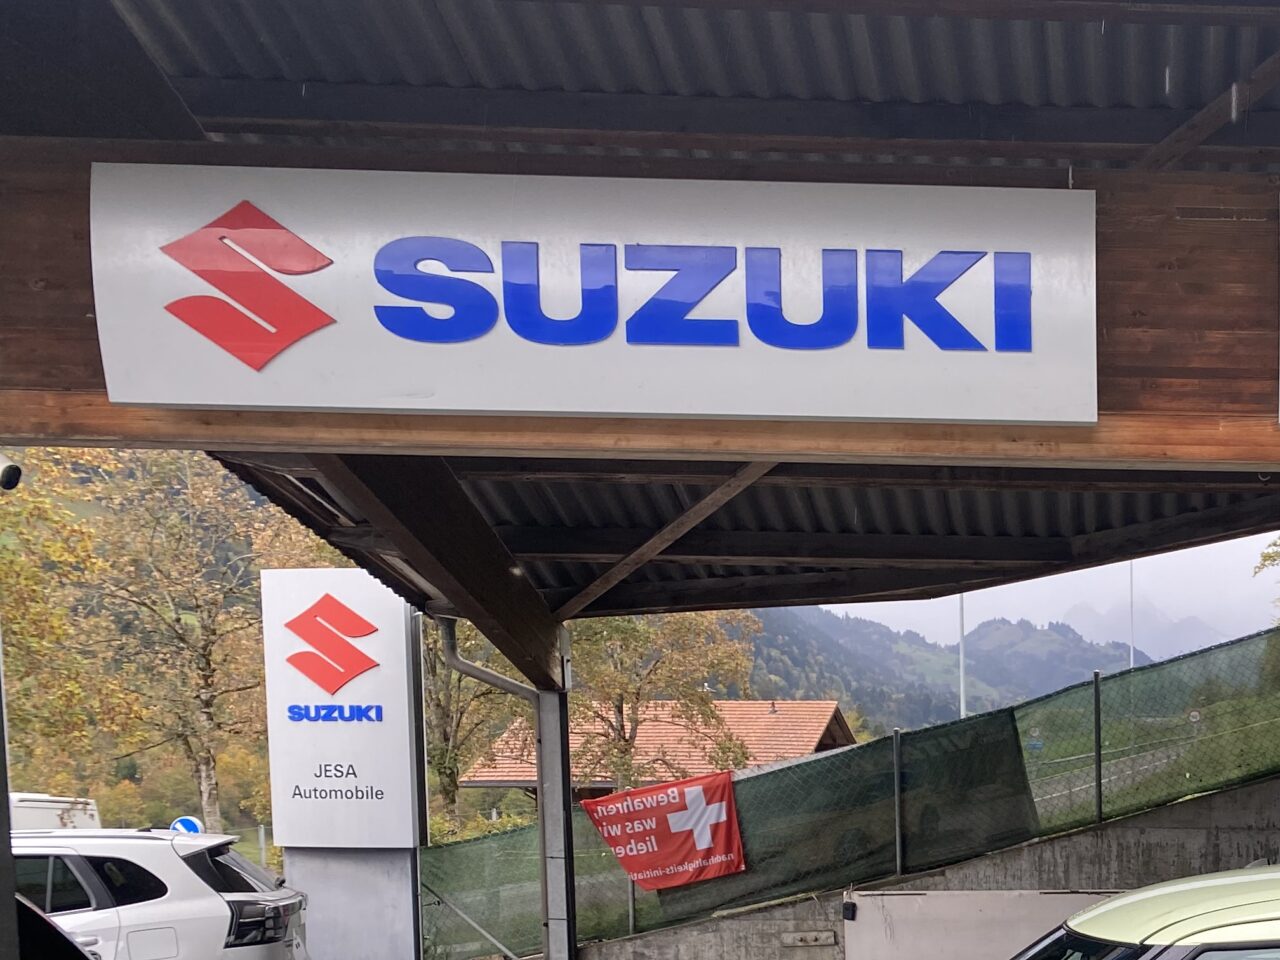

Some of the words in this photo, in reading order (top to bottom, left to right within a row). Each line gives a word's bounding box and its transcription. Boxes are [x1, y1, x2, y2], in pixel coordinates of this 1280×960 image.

[373, 235, 1033, 353] SUZUKI
[287, 704, 383, 722] SUZUKI
[313, 763, 358, 779] JESA
[291, 784, 385, 801] Automobile
